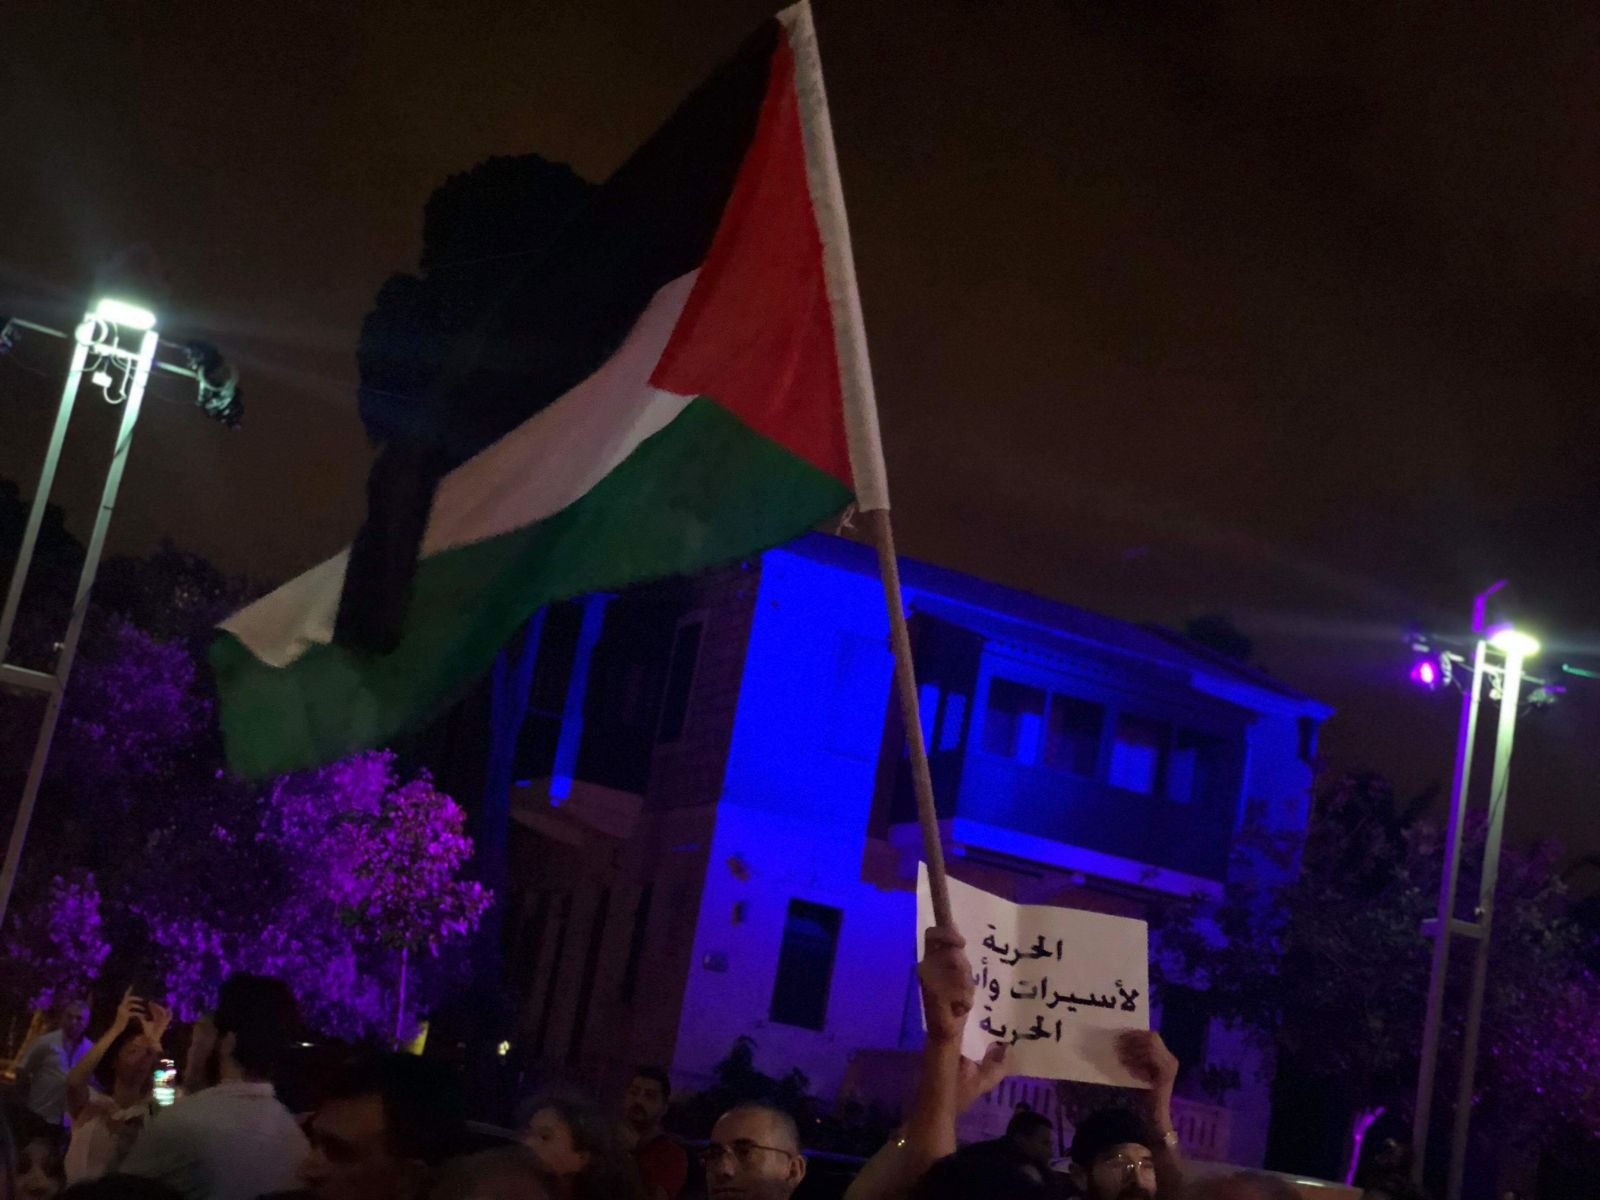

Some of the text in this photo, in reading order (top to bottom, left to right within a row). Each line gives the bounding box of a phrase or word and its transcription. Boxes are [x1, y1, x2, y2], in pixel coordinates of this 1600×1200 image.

[982, 924, 1063, 966] الحرية
[1010, 976, 1139, 1012] لأسيرات
[979, 1005, 1062, 1045] الحرية
